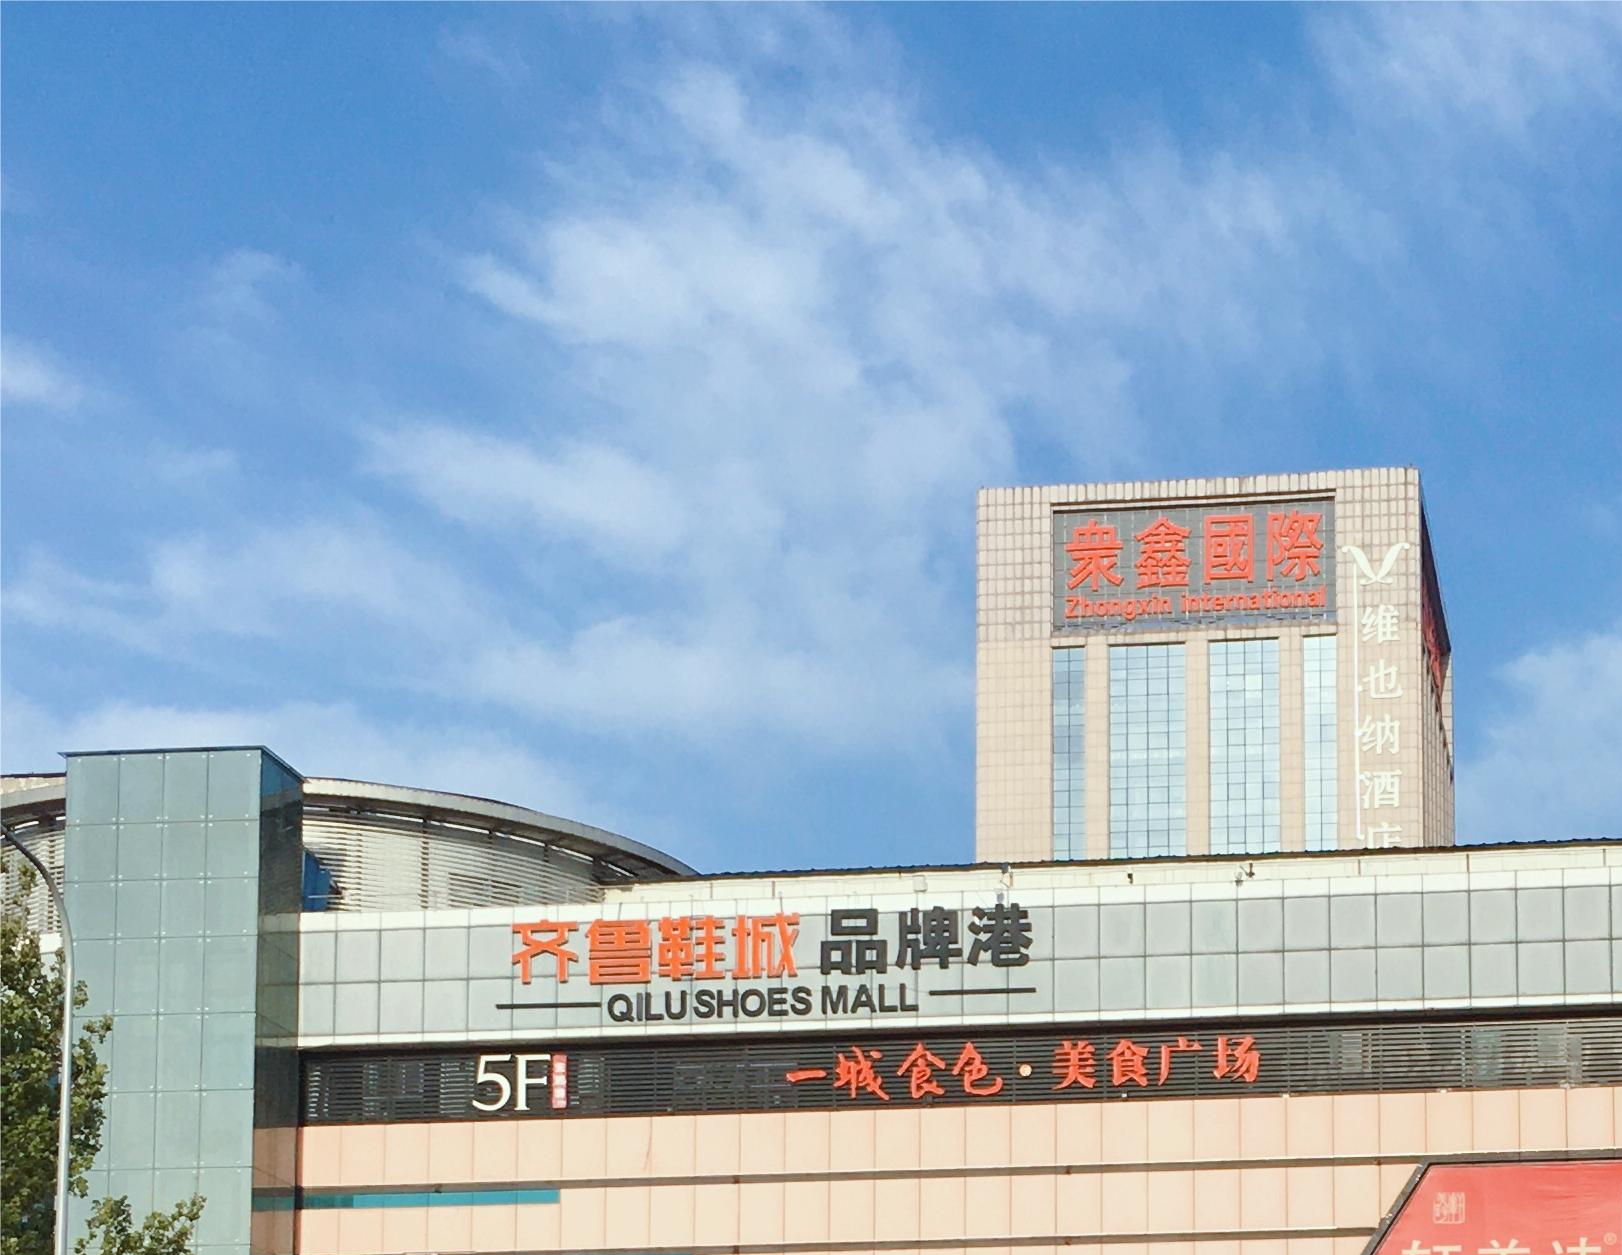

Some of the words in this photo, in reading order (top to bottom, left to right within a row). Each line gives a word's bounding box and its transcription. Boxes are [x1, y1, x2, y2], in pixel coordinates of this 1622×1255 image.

[1065, 592, 1173, 621] Zhongxin
[1180, 586, 1327, 615] international
[511, 911, 801, 985] 齐鲁鞋城
[820, 902, 1033, 976] 品牌港
[821, 982, 919, 1016] MALL
[472, 1053, 551, 1111] 5F
